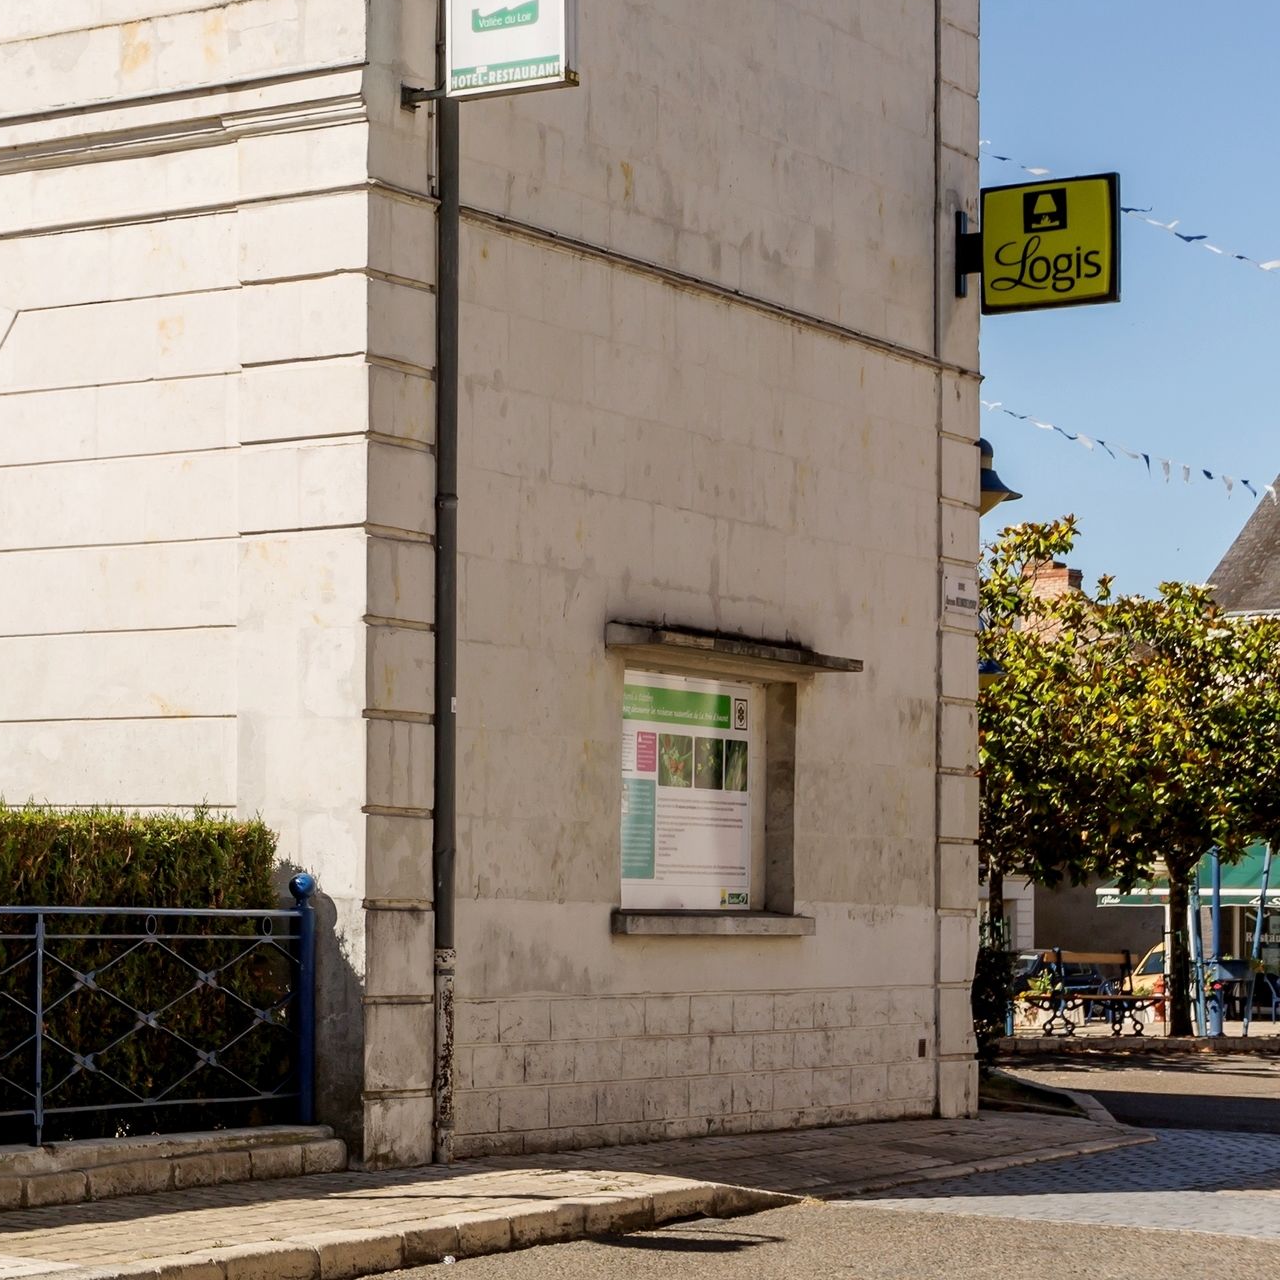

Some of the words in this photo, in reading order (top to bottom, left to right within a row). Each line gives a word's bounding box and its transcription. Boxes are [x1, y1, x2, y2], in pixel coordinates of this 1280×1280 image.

[478, 16, 502, 28] Vallée
[505, 15, 516, 25] du
[517, 13, 532, 23] Loir
[990, 235, 1102, 293] Logis
